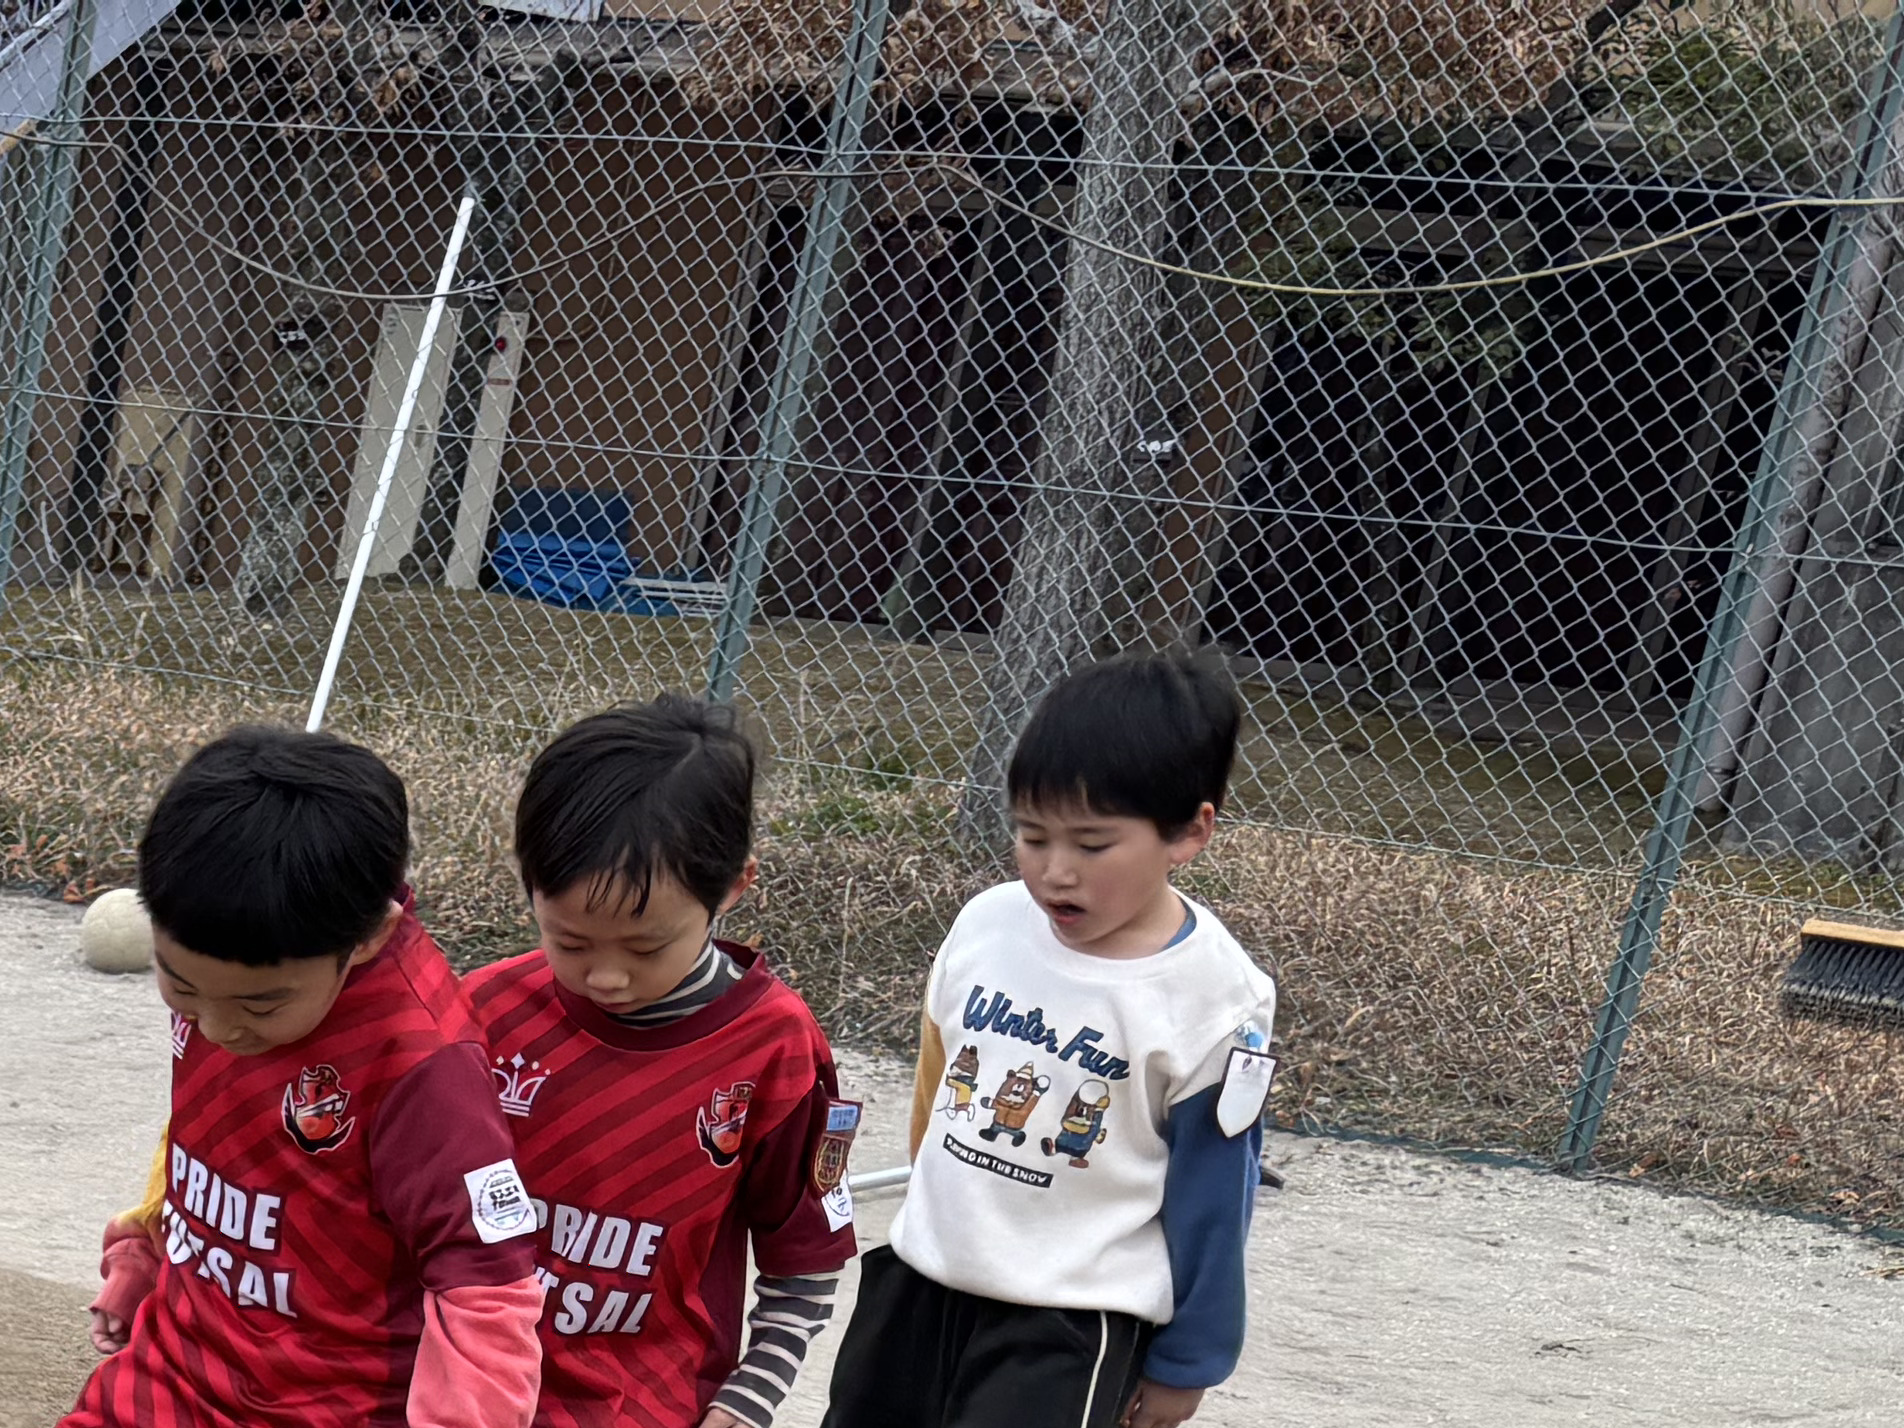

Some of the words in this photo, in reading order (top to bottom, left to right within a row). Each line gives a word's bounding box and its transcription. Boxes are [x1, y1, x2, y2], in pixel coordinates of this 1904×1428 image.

[962, 984, 1059, 1054] Winter
[1057, 1025, 1131, 1080] Fun
[171, 1142, 282, 1251] PRIDE
